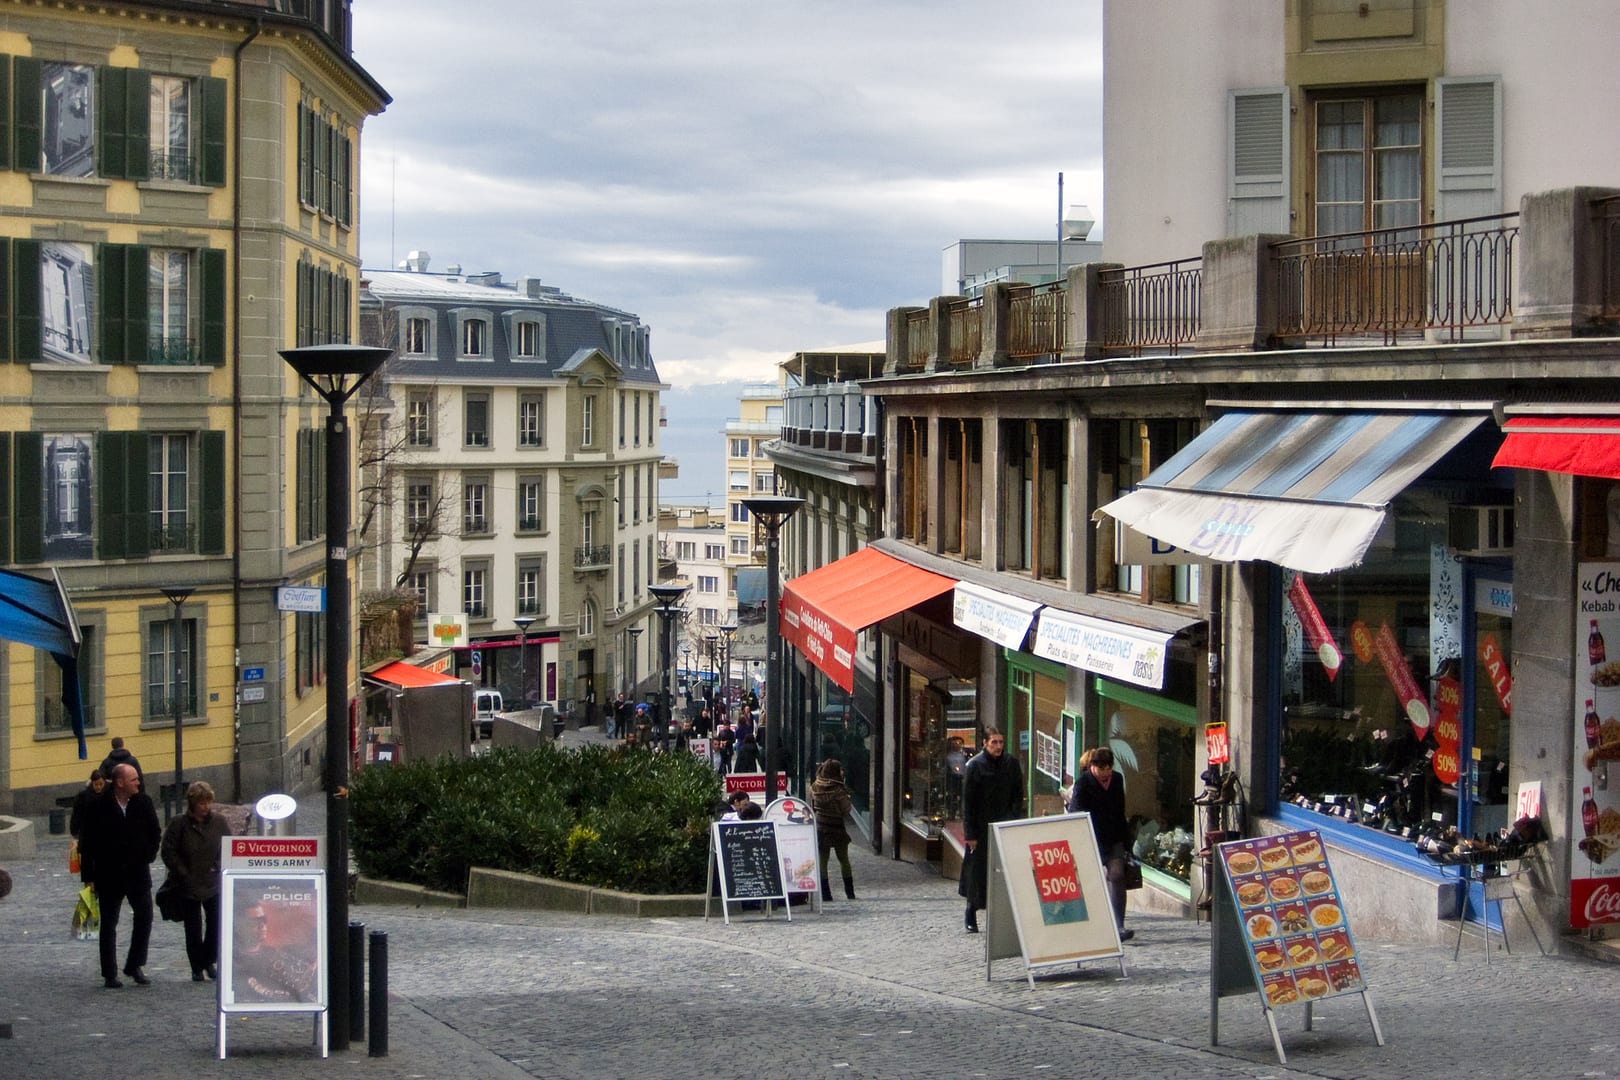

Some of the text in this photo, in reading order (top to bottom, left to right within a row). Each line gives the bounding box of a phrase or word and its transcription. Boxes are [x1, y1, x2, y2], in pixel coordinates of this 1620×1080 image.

[284, 590, 316, 602] Coiffure
[1581, 600, 1615, 612] Kebab
[1039, 621, 1082, 646] SPECIALITES
[1081, 630, 1134, 660] MAGHREBINES
[1047, 642, 1061, 657] Plats
[1061, 648, 1069, 659] du
[1069, 648, 1080, 663] jour
[1484, 645, 1511, 708] SALE
[1441, 687, 1458, 705] 30%
[1439, 721, 1457, 740] 40%
[1437, 754, 1457, 773] 50%
[730, 779, 785, 790] VICTORIX
[248, 842, 312, 853] VICTORINOX
[1034, 847, 1070, 867] 30%
[248, 859, 312, 867] SWISS ARMY
[1042, 876, 1077, 896] 50%
[262, 893, 312, 901] POLICE
[1584, 884, 1620, 921] Coc
